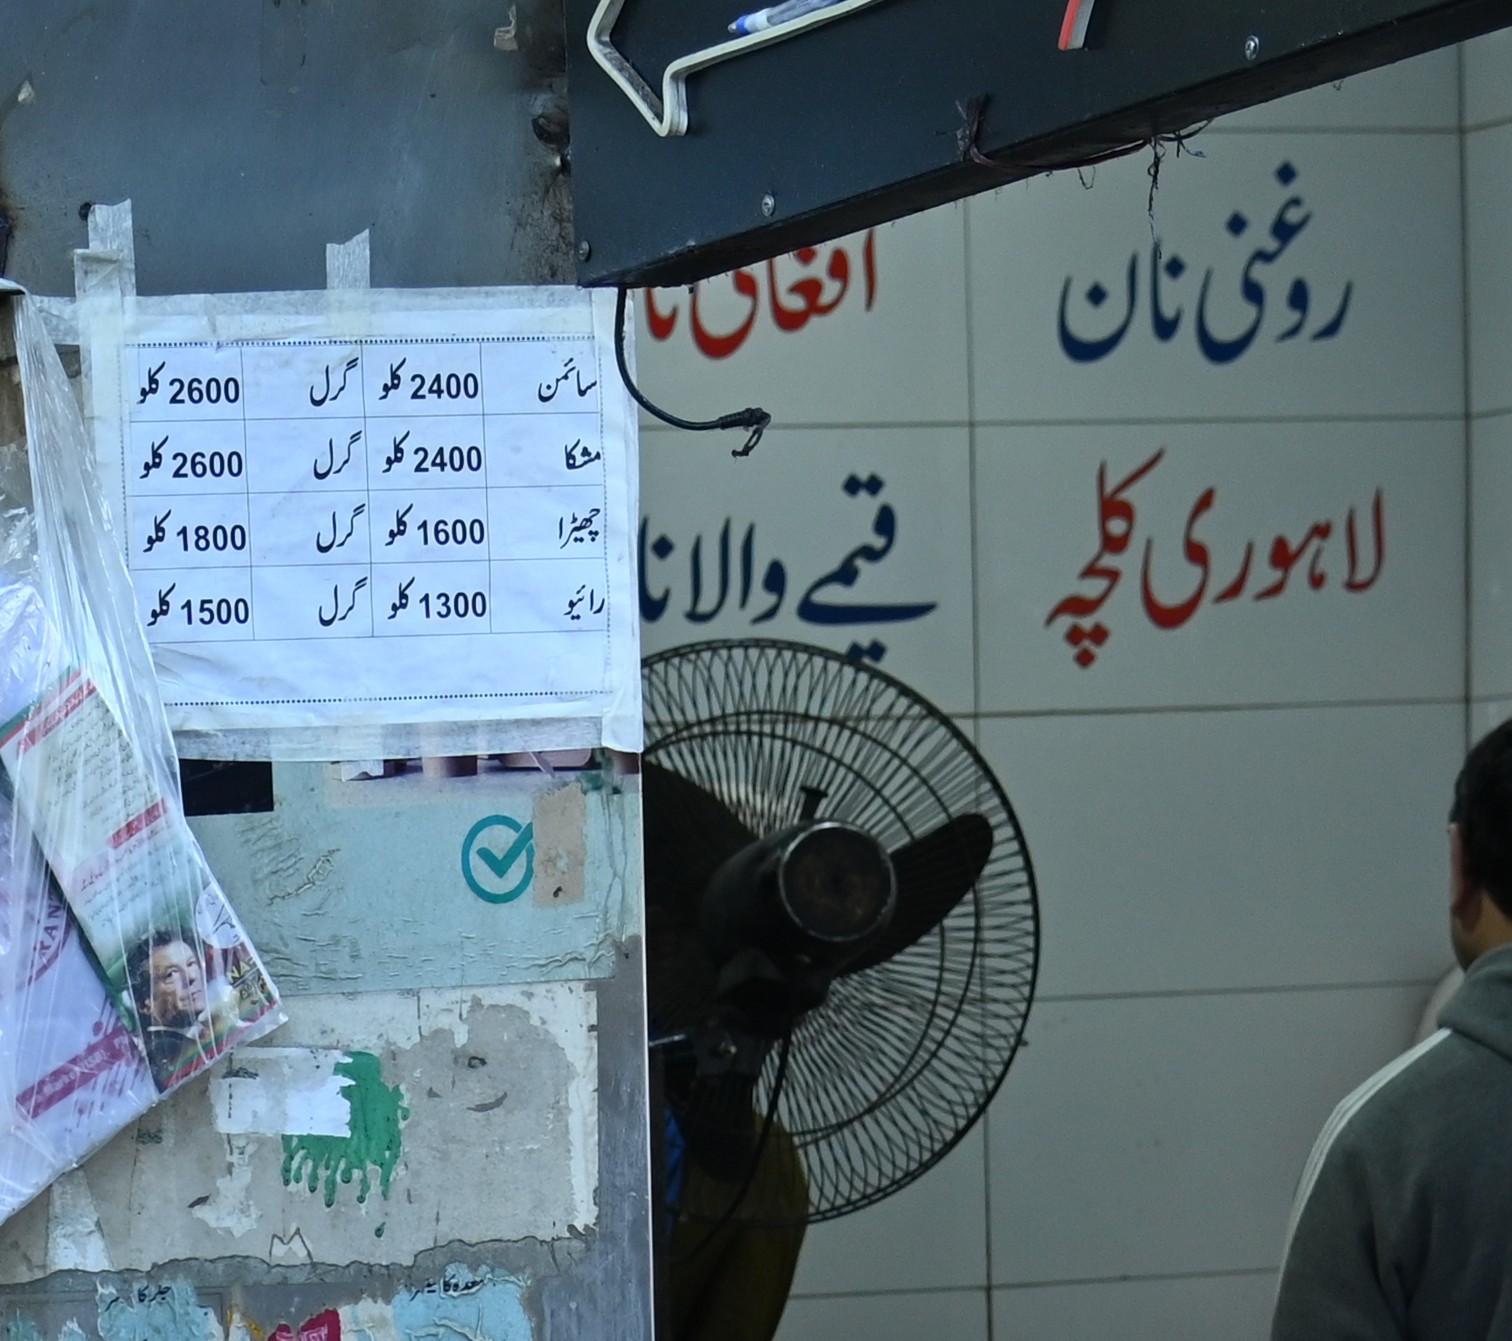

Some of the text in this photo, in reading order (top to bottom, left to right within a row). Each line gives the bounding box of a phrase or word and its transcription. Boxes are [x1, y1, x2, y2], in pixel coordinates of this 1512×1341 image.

[1057, 160, 1353, 366] روغنی نان
[136, 361, 167, 405] کلو
[168, 376, 240, 405] 2600
[310, 356, 360, 407] گرل
[378, 356, 407, 401] کلو
[410, 372, 479, 400] 2400
[139, 435, 170, 479] کلو
[171, 450, 244, 479] 2600
[313, 430, 363, 481] گرل
[382, 430, 411, 474] کلو
[413, 445, 483, 473] 2400
[142, 508, 173, 553] کلو
[176, 524, 247, 552] 1800
[316, 503, 367, 554] گرل
[384, 502, 414, 547] کلو
[417, 518, 486, 546] 1600
[637, 471, 939, 664] قیمے والا نا
[1044, 447, 1387, 669] لاہوری کلچہ
[147, 582, 176, 627] کلو
[180, 597, 249, 626] 1500
[318, 576, 369, 627] گرل
[387, 576, 416, 620] کلو
[419, 591, 488, 619] 1300
